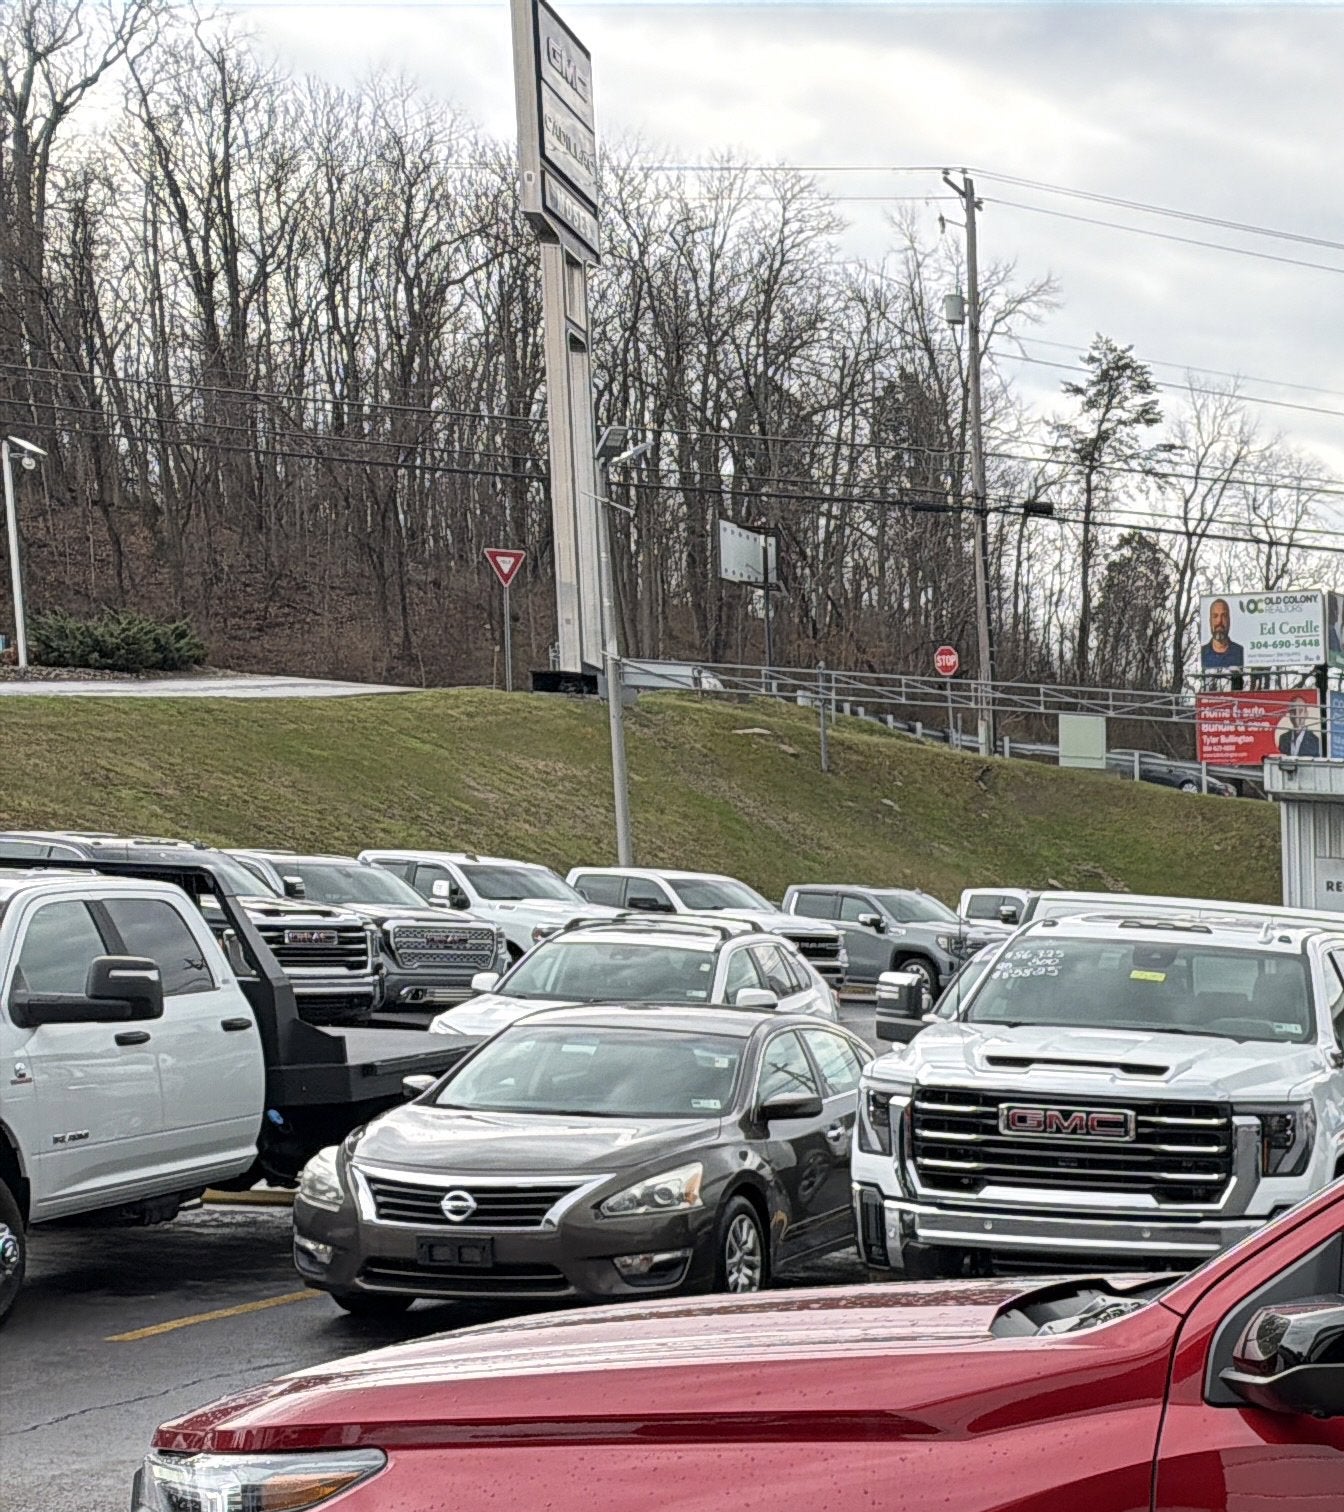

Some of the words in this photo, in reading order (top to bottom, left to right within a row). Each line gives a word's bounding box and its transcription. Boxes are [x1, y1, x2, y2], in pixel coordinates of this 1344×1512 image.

[547, 37, 589, 104] GMC
[1264, 596, 1281, 605] OLD
[1282, 594, 1318, 605] COLONY
[1260, 622, 1275, 636] Ed
[1279, 620, 1320, 635] Cordle
[1249, 639, 1320, 650] 304-690-5448
[937, 655, 957, 667] STOP
[1008, 1108, 1126, 1136] GMC
